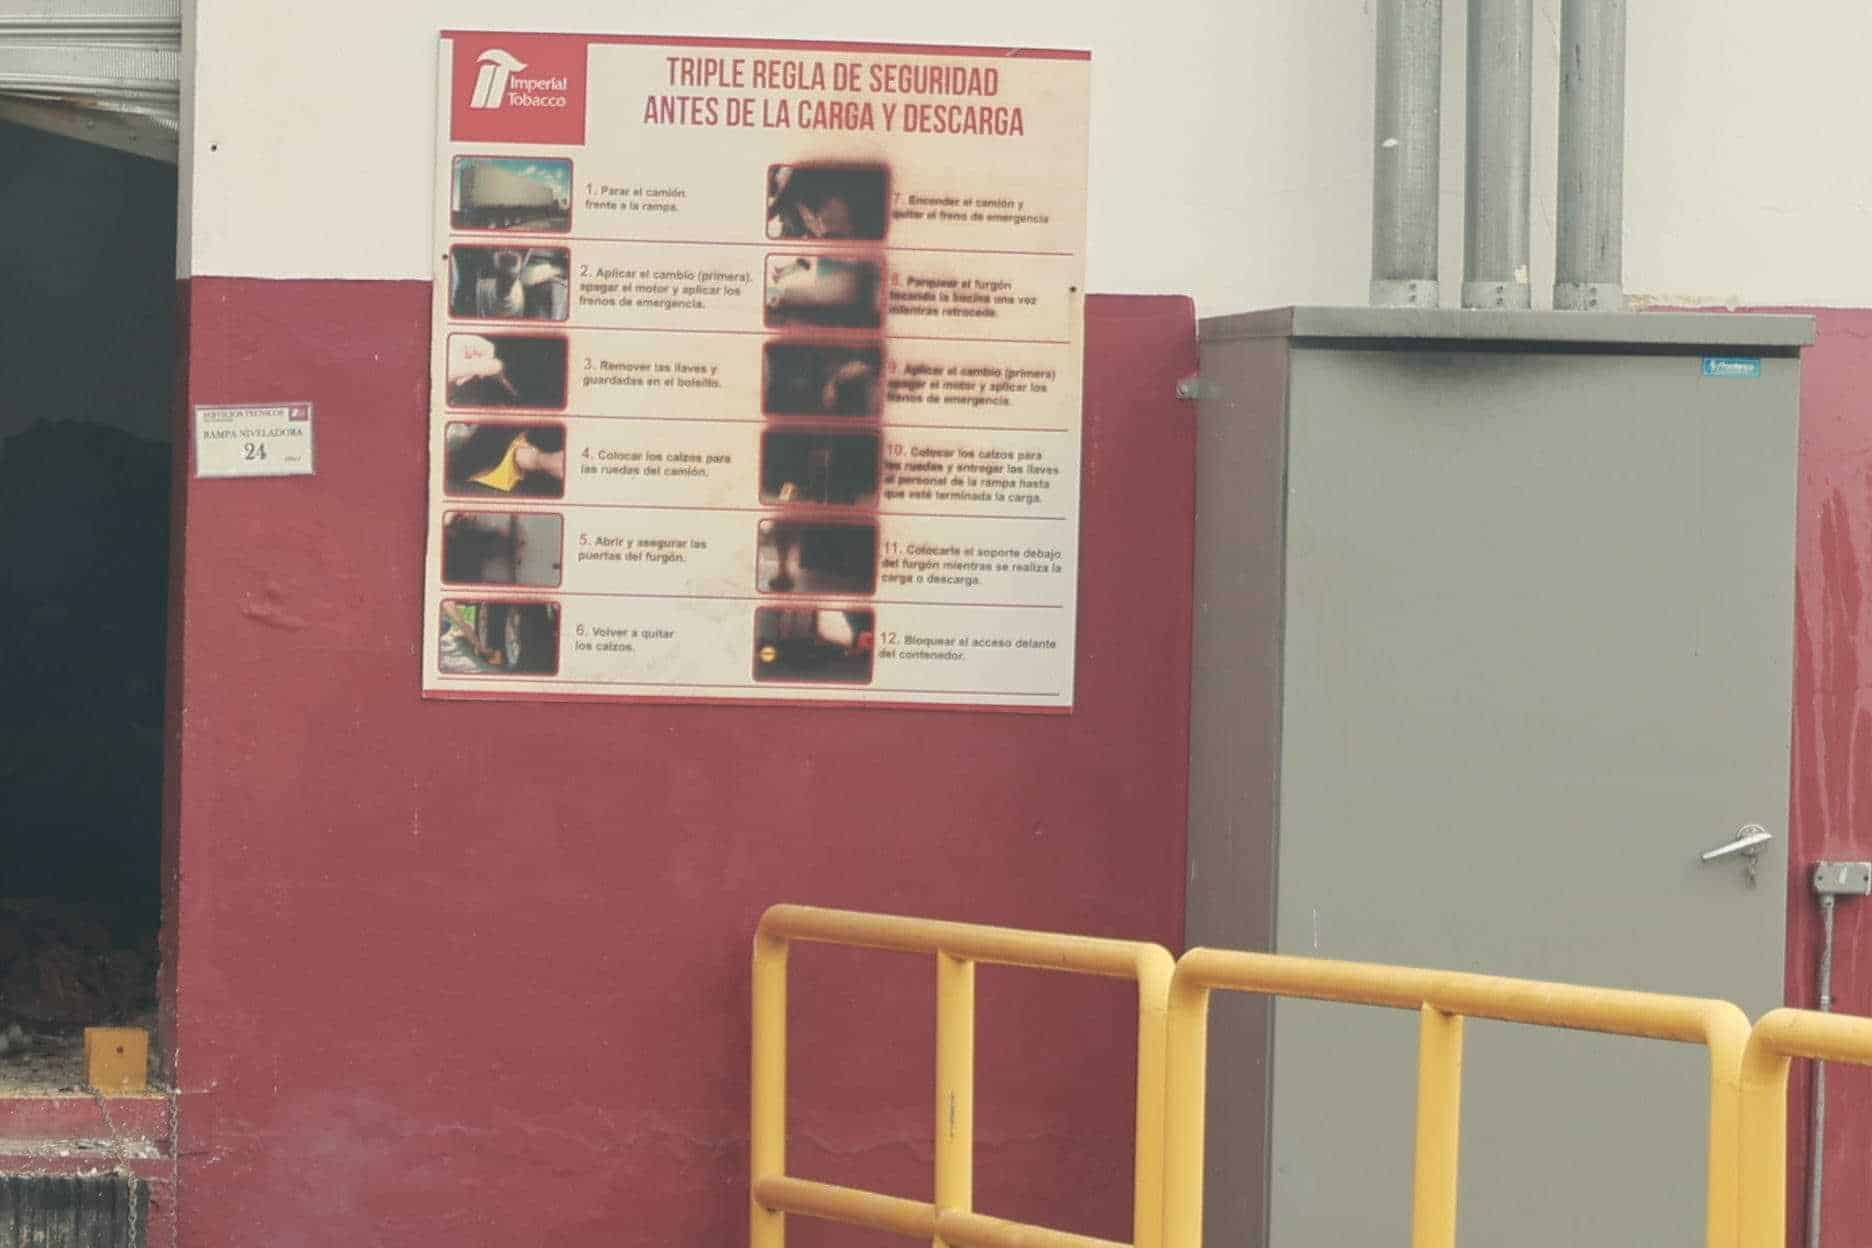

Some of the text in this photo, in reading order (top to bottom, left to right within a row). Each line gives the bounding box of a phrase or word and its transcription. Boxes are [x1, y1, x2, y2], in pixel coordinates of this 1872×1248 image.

[667, 57, 998, 96] TRIPLE REGLA DE SEGURIDAD
[511, 75, 568, 92] Imperial
[510, 93, 566, 107] Tobacco
[644, 95, 1024, 136] ANTES DE LA CARGA Y DESCARGA
[601, 186, 629, 196] Parar
[633, 188, 642, 196] el
[585, 200, 616, 209] frente
[620, 202, 626, 210] a
[630, 201, 639, 210] la
[596, 268, 635, 279] Aplicar
[640, 269, 649, 278] el
[653, 270, 694, 280] cambio
[579, 283, 741, 296] apagar el motor y aplicar los
[579, 296, 615, 305] frenos
[619, 297, 632, 306] de
[600, 360, 650, 371] Remover
[654, 362, 670, 372] las
[675, 362, 706, 373] llaves
[710, 365, 717, 375] y
[961, 367, 1001, 377] cambio
[647, 378, 659, 386] en
[664, 378, 674, 387] el
[943, 382, 976, 390] motor
[990, 384, 1027, 393] aplicar
[1030, 384, 1047, 392] los
[244, 443, 266, 460] 24
[598, 450, 642, 461] Colocar
[646, 451, 662, 461] los
[706, 454, 731, 464] para
[959, 449, 975, 458] los
[1018, 452, 1042, 461] para
[581, 465, 597, 474] las
[601, 466, 639, 475] ruedas
[643, 466, 660, 475] del
[947, 465, 952, 473] y
[951, 477, 963, 485] de
[968, 478, 976, 486] la
[981, 480, 1015, 489] rampa
[1020, 480, 1050, 488] hasta
[936, 492, 991, 501] terminada
[995, 493, 1005, 501] la
[595, 536, 623, 546] Abrir
[627, 540, 632, 548] y
[637, 539, 687, 550] asegurar
[690, 540, 706, 549] las
[578, 552, 621, 562] puertas
[625, 552, 642, 561] del
[964, 547, 974, 555] el
[977, 548, 1020, 559] soporte
[1024, 549, 1060, 561] debajo
[882, 560, 1062, 573] del furgón mientras se realiza la
[592, 627, 627, 637] Volver
[641, 629, 674, 640] quitar
[575, 641, 592, 650] los
[904, 635, 955, 648] Bloquear
[959, 638, 968, 647] el
[972, 640, 1011, 648] acceso
[1016, 639, 1056, 648] delante
[880, 651, 895, 659] del
